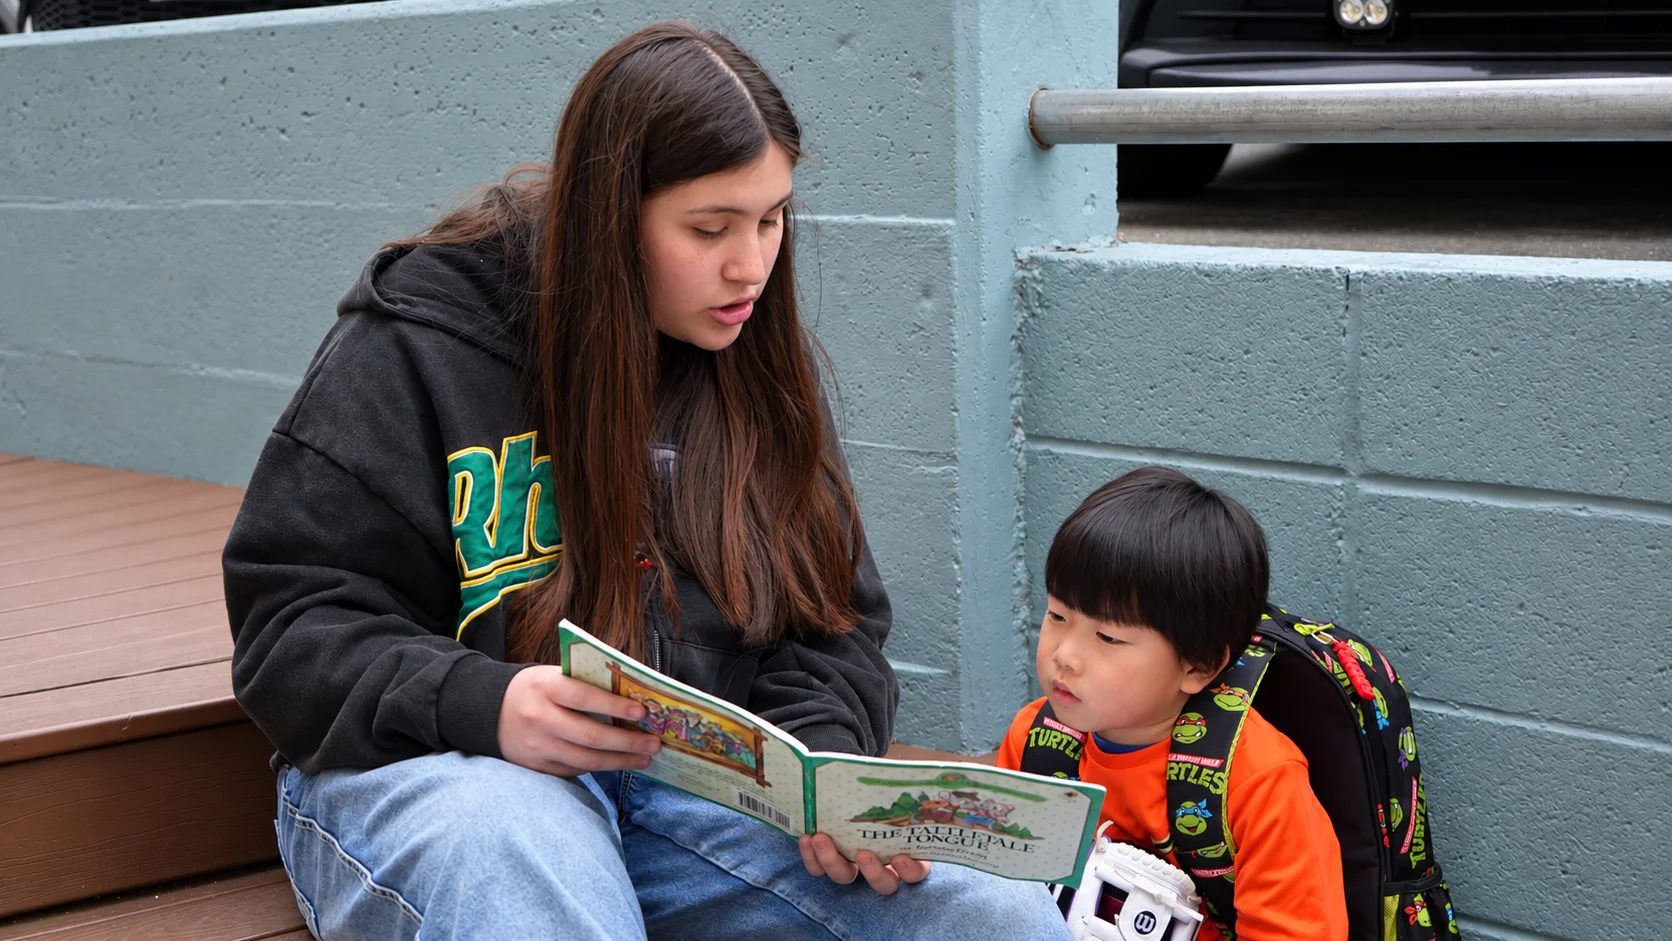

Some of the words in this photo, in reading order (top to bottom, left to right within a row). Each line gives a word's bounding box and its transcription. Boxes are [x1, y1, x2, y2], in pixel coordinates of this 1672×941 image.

[447, 431, 564, 578] Rh
[1029, 727, 1082, 760] TURTL
[1167, 762, 1226, 794] RTLES
[857, 829, 901, 839] THE
[906, 826, 1035, 853] TATTLETALE
[903, 835, 989, 852] TONGUE
